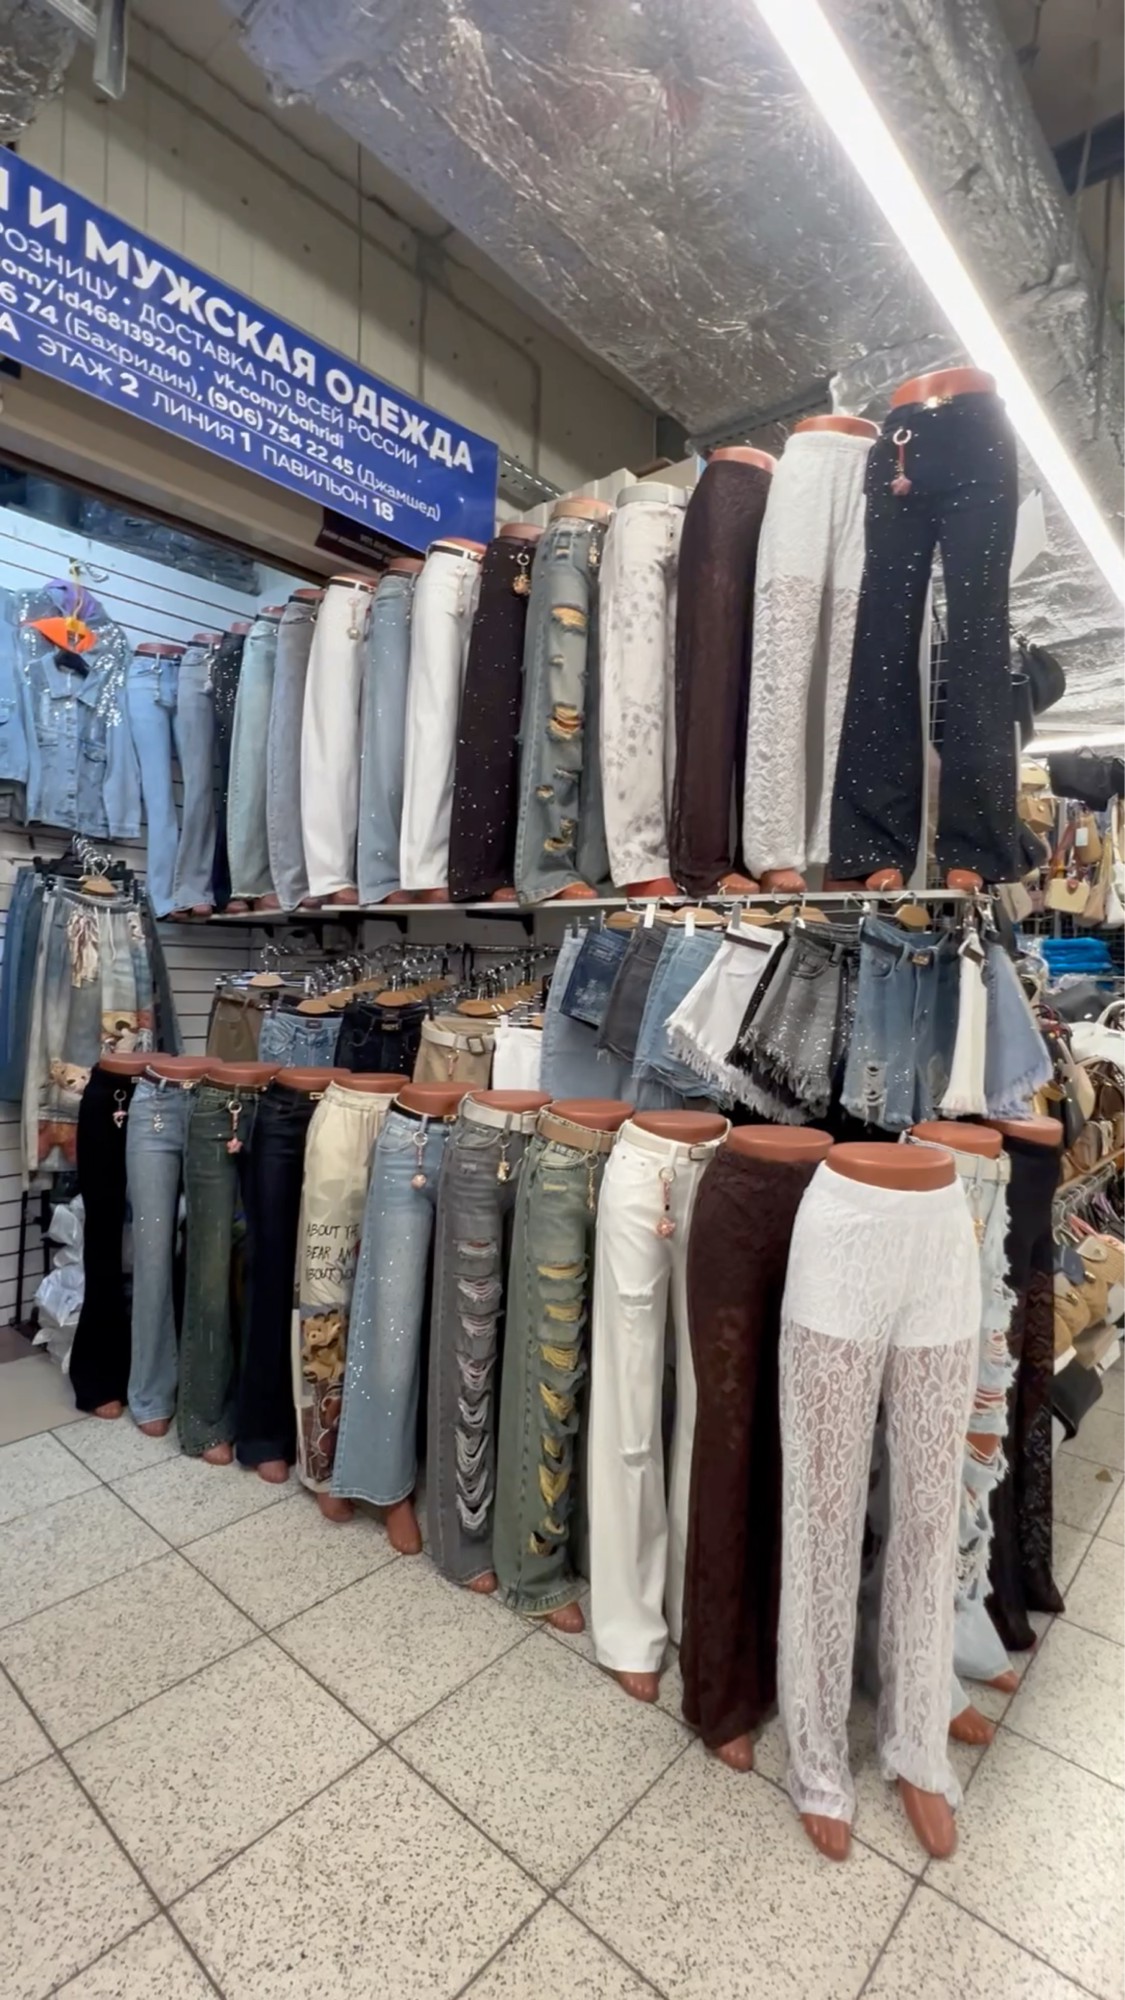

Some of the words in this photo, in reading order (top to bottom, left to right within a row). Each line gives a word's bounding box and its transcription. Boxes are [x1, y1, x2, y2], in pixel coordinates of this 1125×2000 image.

[0, 257, 191, 367] om/id468139240
[213, 370, 344, 450] vk.com/bahridi
[23, 292, 59, 325] 74
[65, 312, 203, 401] (Бахридин),
[208, 386, 263, 431] (906)
[267, 418, 303, 450] 754
[306, 439, 329, 464] 22
[331, 452, 354, 476] 45
[356, 463, 441, 522] (Джамшед)
[29, 185, 67, 244] И
[86, 219, 316, 388] МУЖСКАЯ
[325, 368, 474, 474] ОДЕЖДА
[139, 304, 257, 382] ДОСТАВКА
[261, 371, 291, 397] ПО
[296, 389, 343, 429] ВСЕЙ
[348, 417, 417, 468] РОССИИ
[36, 333, 114, 386] ЭТАЖ
[119, 372, 139, 398] 2
[152, 391, 235, 445] ЛИНИЯ
[240, 431, 251, 452] 1
[262, 444, 367, 510] ПАВИЛЬОН
[371, 497, 395, 522] 18
